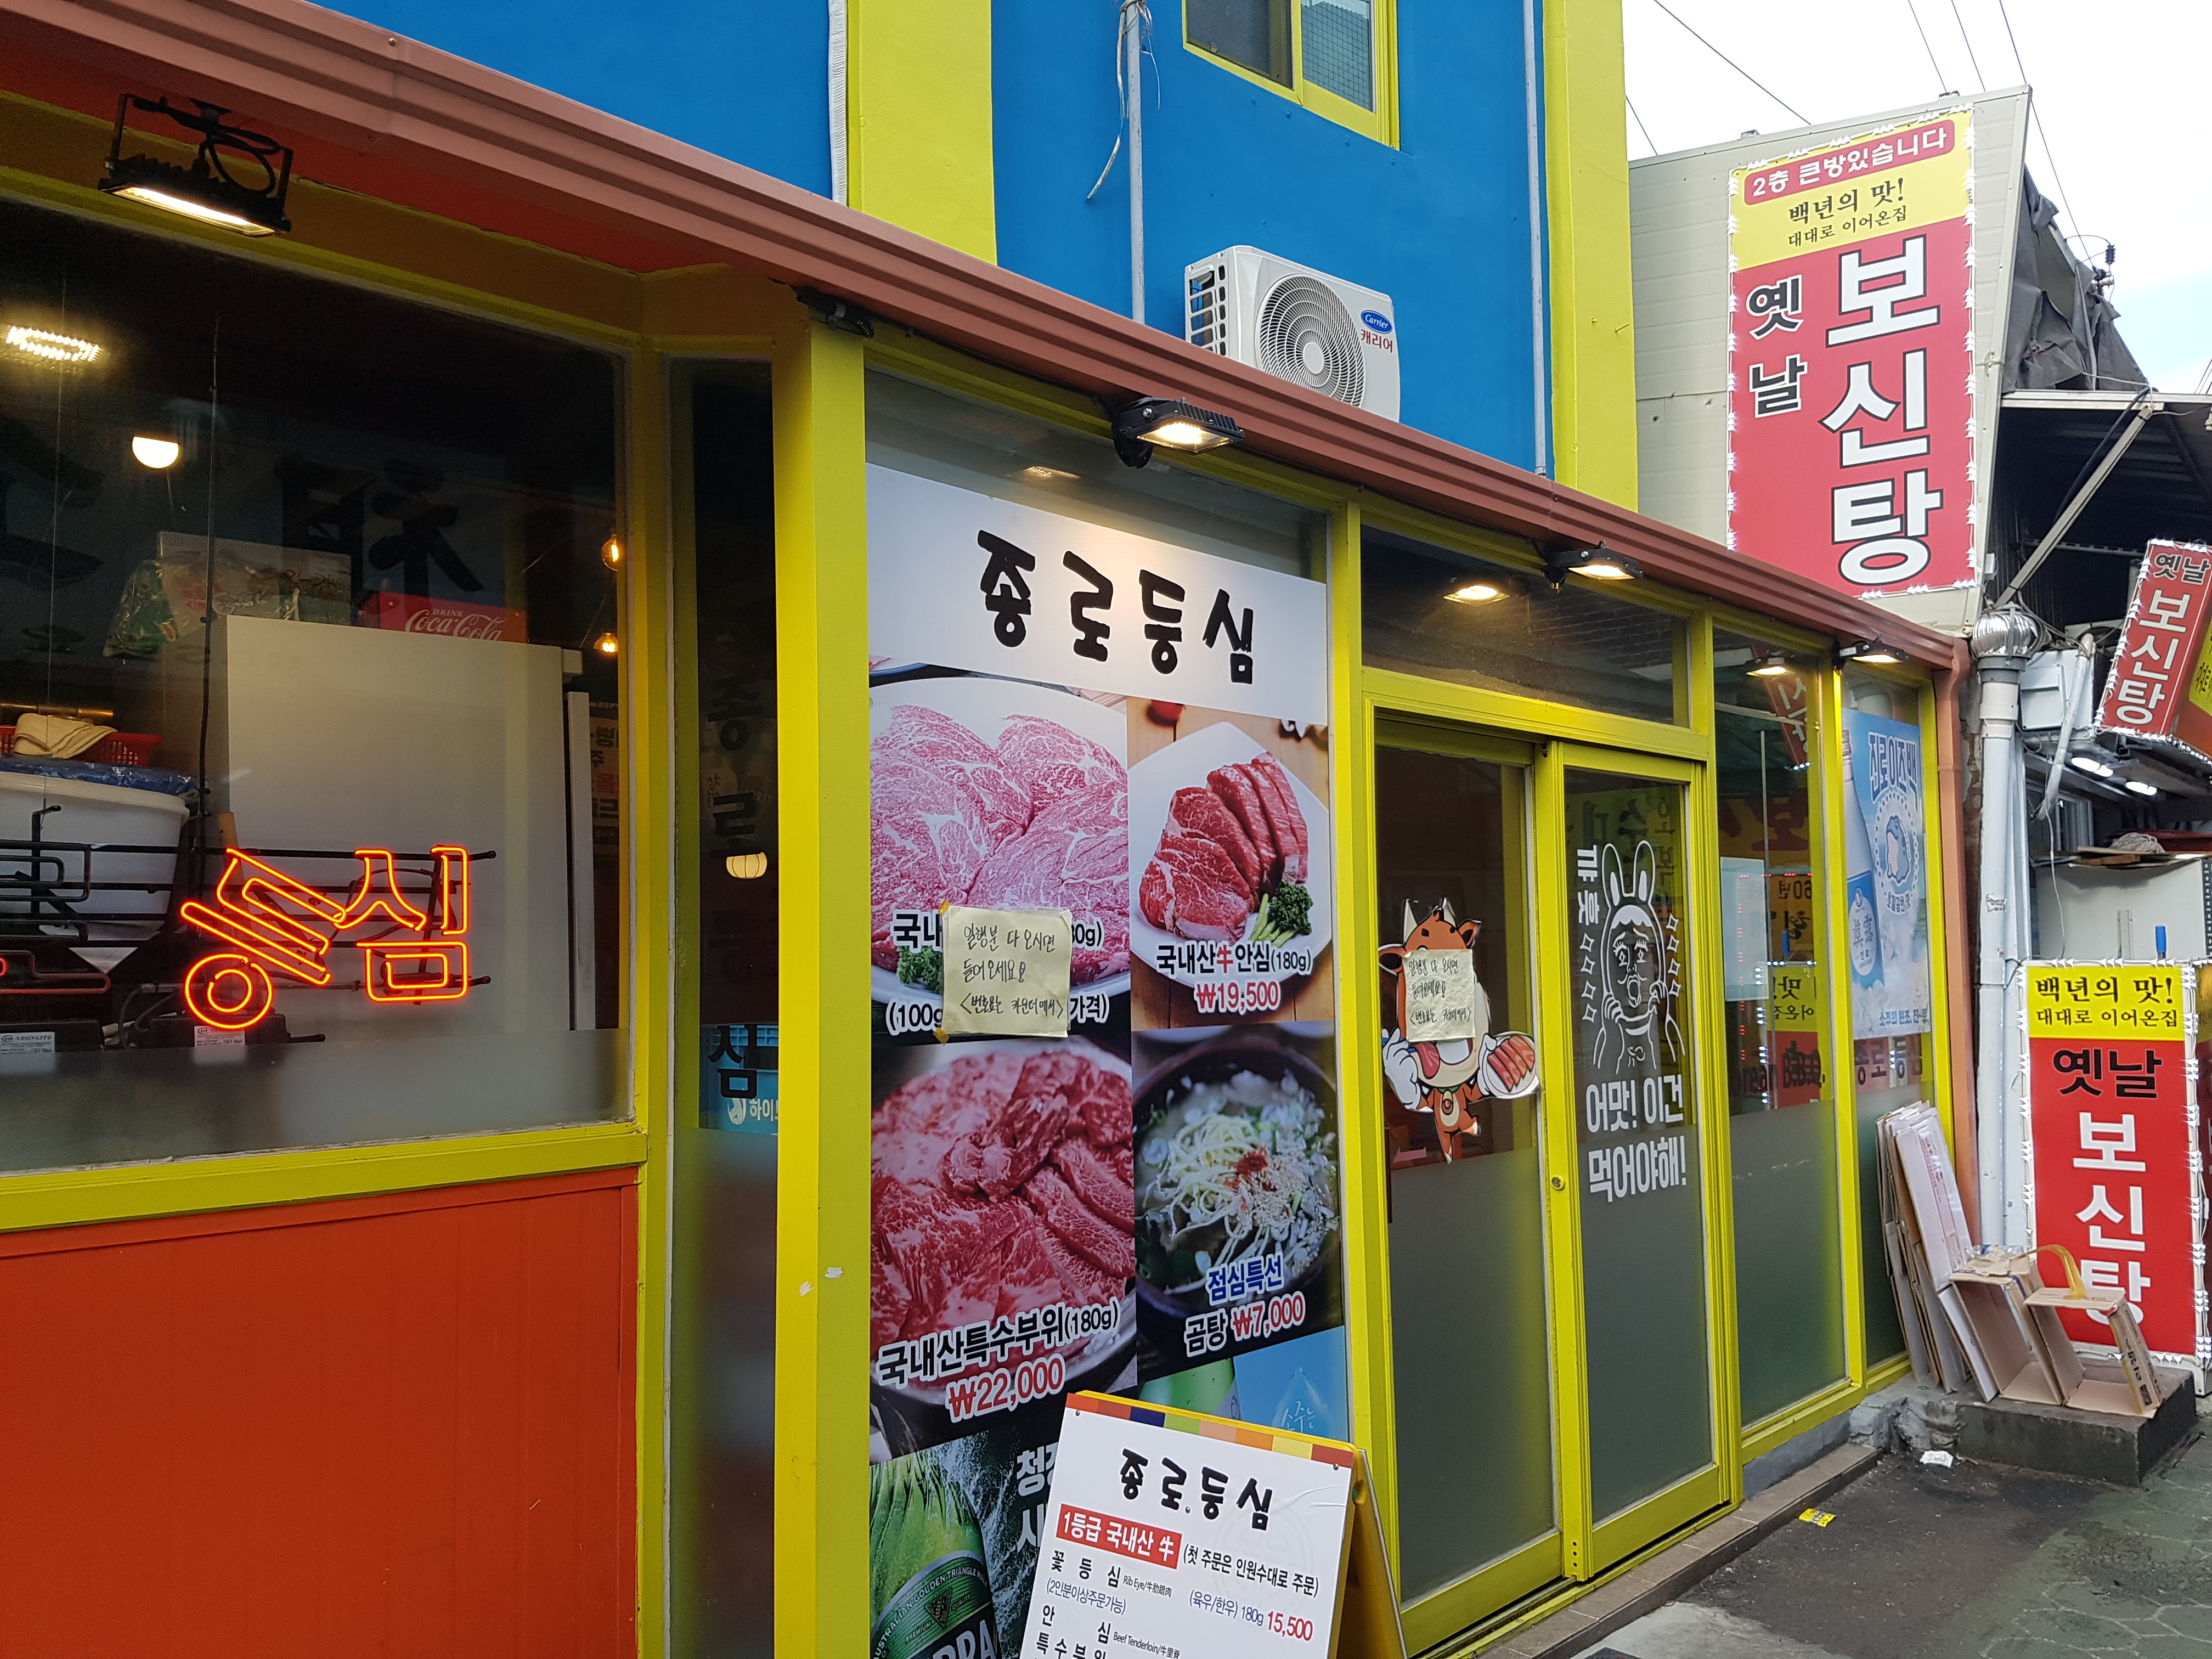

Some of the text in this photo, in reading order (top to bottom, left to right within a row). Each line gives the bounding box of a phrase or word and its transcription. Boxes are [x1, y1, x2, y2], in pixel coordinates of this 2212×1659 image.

[1752, 127, 1948, 198] 2층 큰방있습니다
[1788, 177, 1904, 224] 백년의 맛!
[1787, 205, 1908, 247] 대대로 이어온집
[1361, 329, 1393, 353] 캐리어
[1364, 313, 1389, 329] Carrier
[1747, 275, 1807, 418] 옛날
[1818, 234, 1943, 585] 보신탕
[2153, 554, 2211, 585] 옛날
[405, 609, 506, 641] Coca-Cola
[432, 608, 465, 618] DRINK
[977, 529, 1254, 685] 종로등심
[2115, 589, 2191, 725] 보신탕
[181, 846, 468, 1029] 등심
[963, 922, 1056, 953] 일행분 다 오시면
[1431, 959, 1437, 973] 다
[1442, 958, 1459, 974] 오시면
[1196, 980, 1279, 1011] ₩19,500
[2035, 976, 2174, 1004] 백년의 맛!
[2036, 1008, 2093, 1026] 대대로
[2101, 1008, 2177, 1028] 이어온집
[2052, 1048, 2162, 1099] 옛날
[749, 1098, 778, 1122] 하이
[1585, 1079, 1637, 1133] 어맛!
[1643, 1074, 1684, 1124] 이건
[1588, 1135, 1687, 1203] 먹어야해!
[2073, 1112, 2151, 1325] 보신탕
[1207, 1255, 1282, 1302] 점심특선
[1186, 1294, 1304, 1352] 곰탕 ₩7,000
[949, 1358, 1063, 1418] ₩22,000
[1120, 1448, 1273, 1531] 종로등심
[1064, 1511, 1175, 1561] 1등급 국내산 牛
[946, 1566, 977, 1580] TRIANGLE
[1123, 1575, 1133, 1587] Rib
[1183, 1543, 1319, 1598] (첫 주문은 인원수대로 주문)
[905, 1621, 932, 1643] PREMIUM
[950, 1594, 972, 1611] QUALITY
[1047, 1577, 1126, 1616] (2인분이상주문가능)
[1189, 1589, 1313, 1641] (육우/한우) 180g 15,500
[1113, 1631, 1127, 1645] Beef
